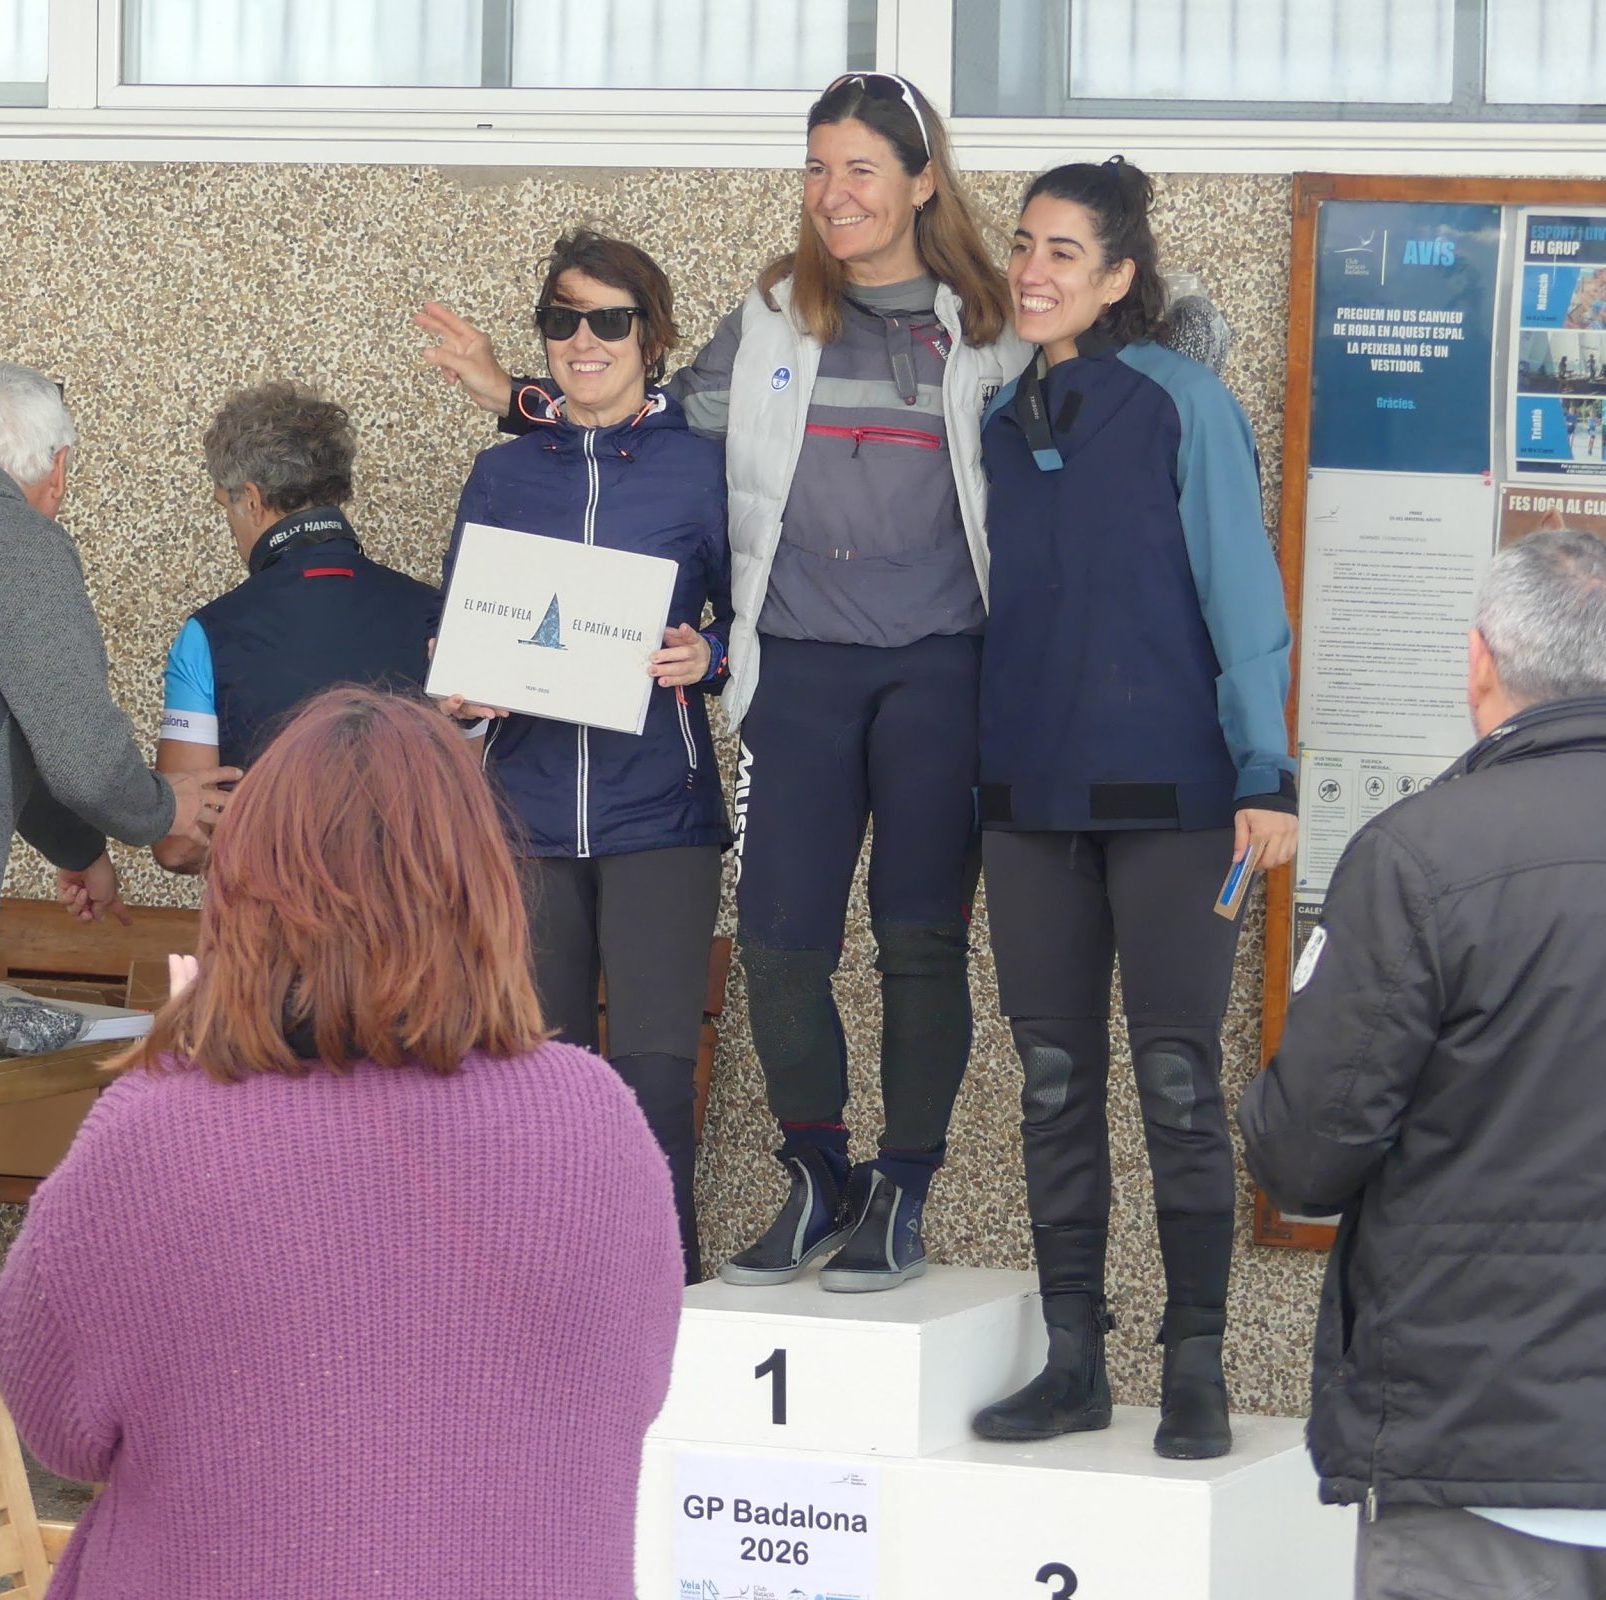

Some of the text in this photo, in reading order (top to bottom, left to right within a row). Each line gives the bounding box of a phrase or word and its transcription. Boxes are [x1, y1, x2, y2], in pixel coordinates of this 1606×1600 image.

[1402, 236, 1456, 267] AVÍS
[1529, 240, 1580, 256] EN GRUP
[1336, 307, 1463, 324] PREGUEM NO US CANVIEU
[1333, 323, 1465, 341] DE ROBA EN AQUEST ESPAI.
[1346, 342, 1449, 358] LA PEIXERA NO ÉS UN
[778, 369, 787, 378] N
[1370, 358, 1424, 373] VESTIDOR.
[1376, 396, 1417, 410] Gràcies.
[1508, 495, 1531, 511] FES
[1565, 498, 1582, 514] AL
[268, 520, 343, 548] HELLY HANSEN
[464, 598, 532, 621] EL PATÍ DE VELA
[572, 618, 642, 642] EL PATÍN A VELA
[1297, 906, 1322, 915] CALE
[754, 1348, 787, 1425] 1
[682, 1494, 868, 1533] GP Badalona
[740, 1536, 810, 1566] 2026
[680, 1578, 701, 1590] Vela
